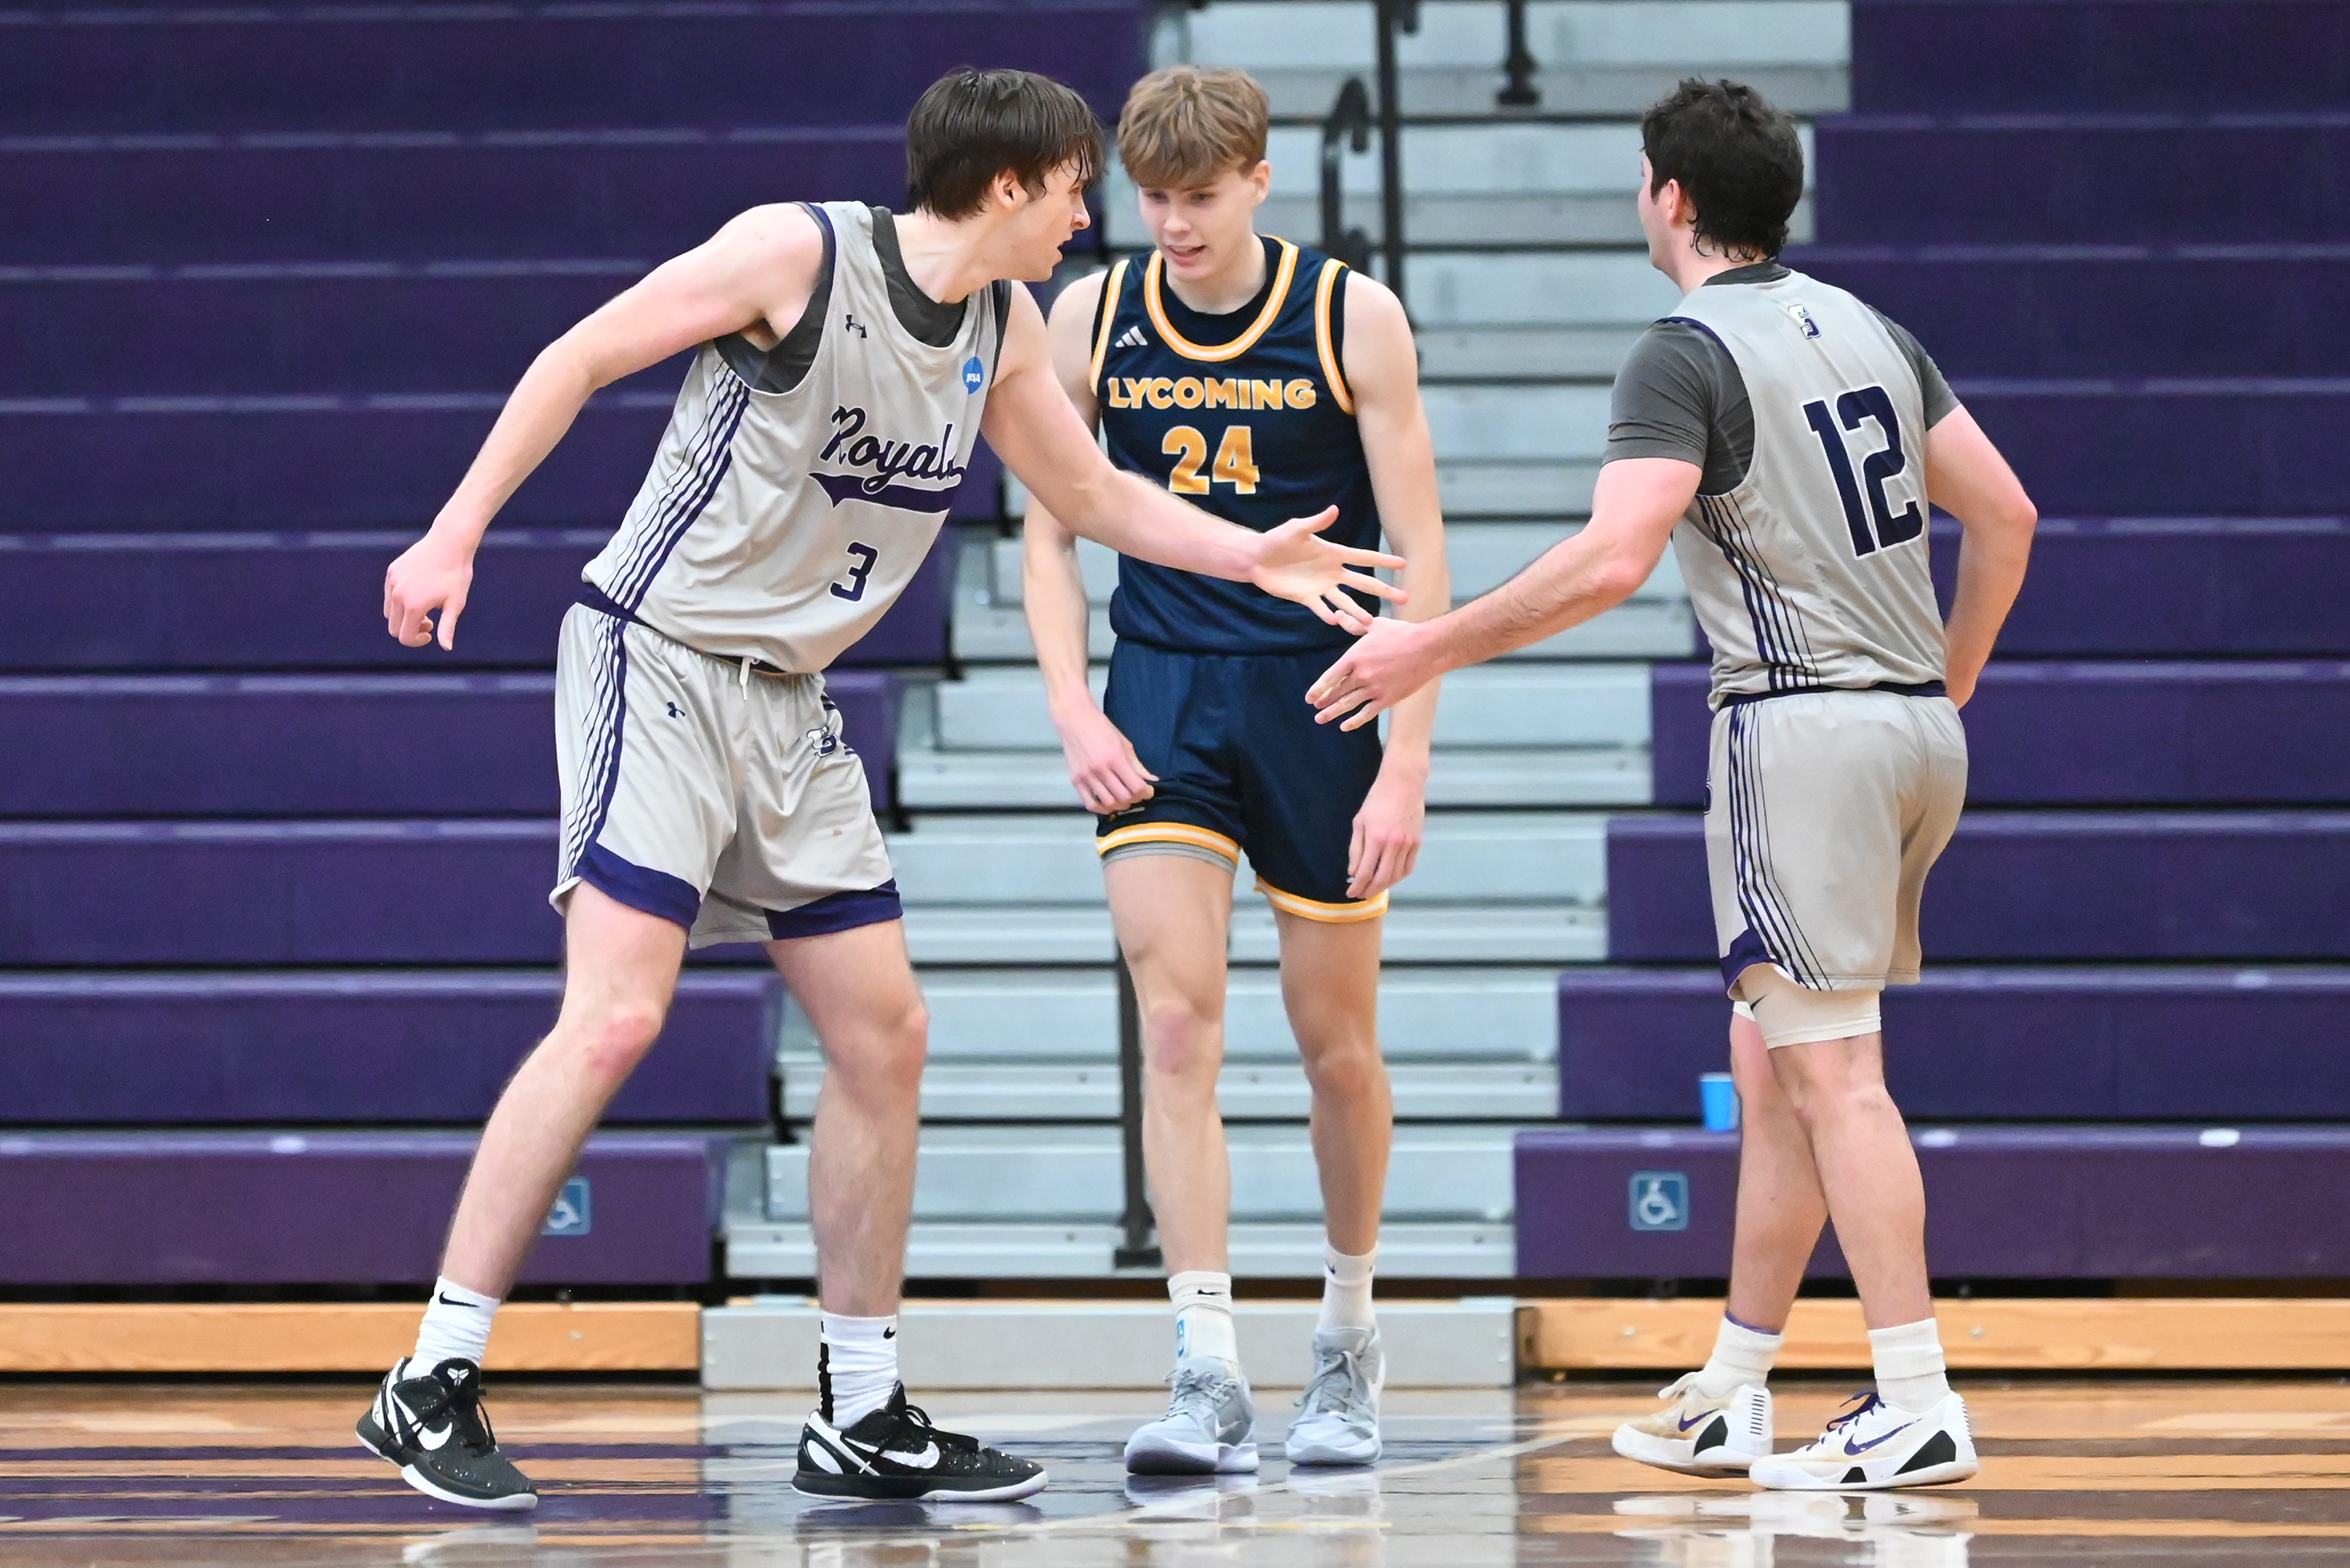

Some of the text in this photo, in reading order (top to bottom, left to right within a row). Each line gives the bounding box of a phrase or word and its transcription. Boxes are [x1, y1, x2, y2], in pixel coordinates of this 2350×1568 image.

[1108, 377, 1317, 410] LYCOMING
[1162, 425, 1260, 495] 24
[1800, 382, 1924, 560] 12
[830, 541, 878, 602] 3
